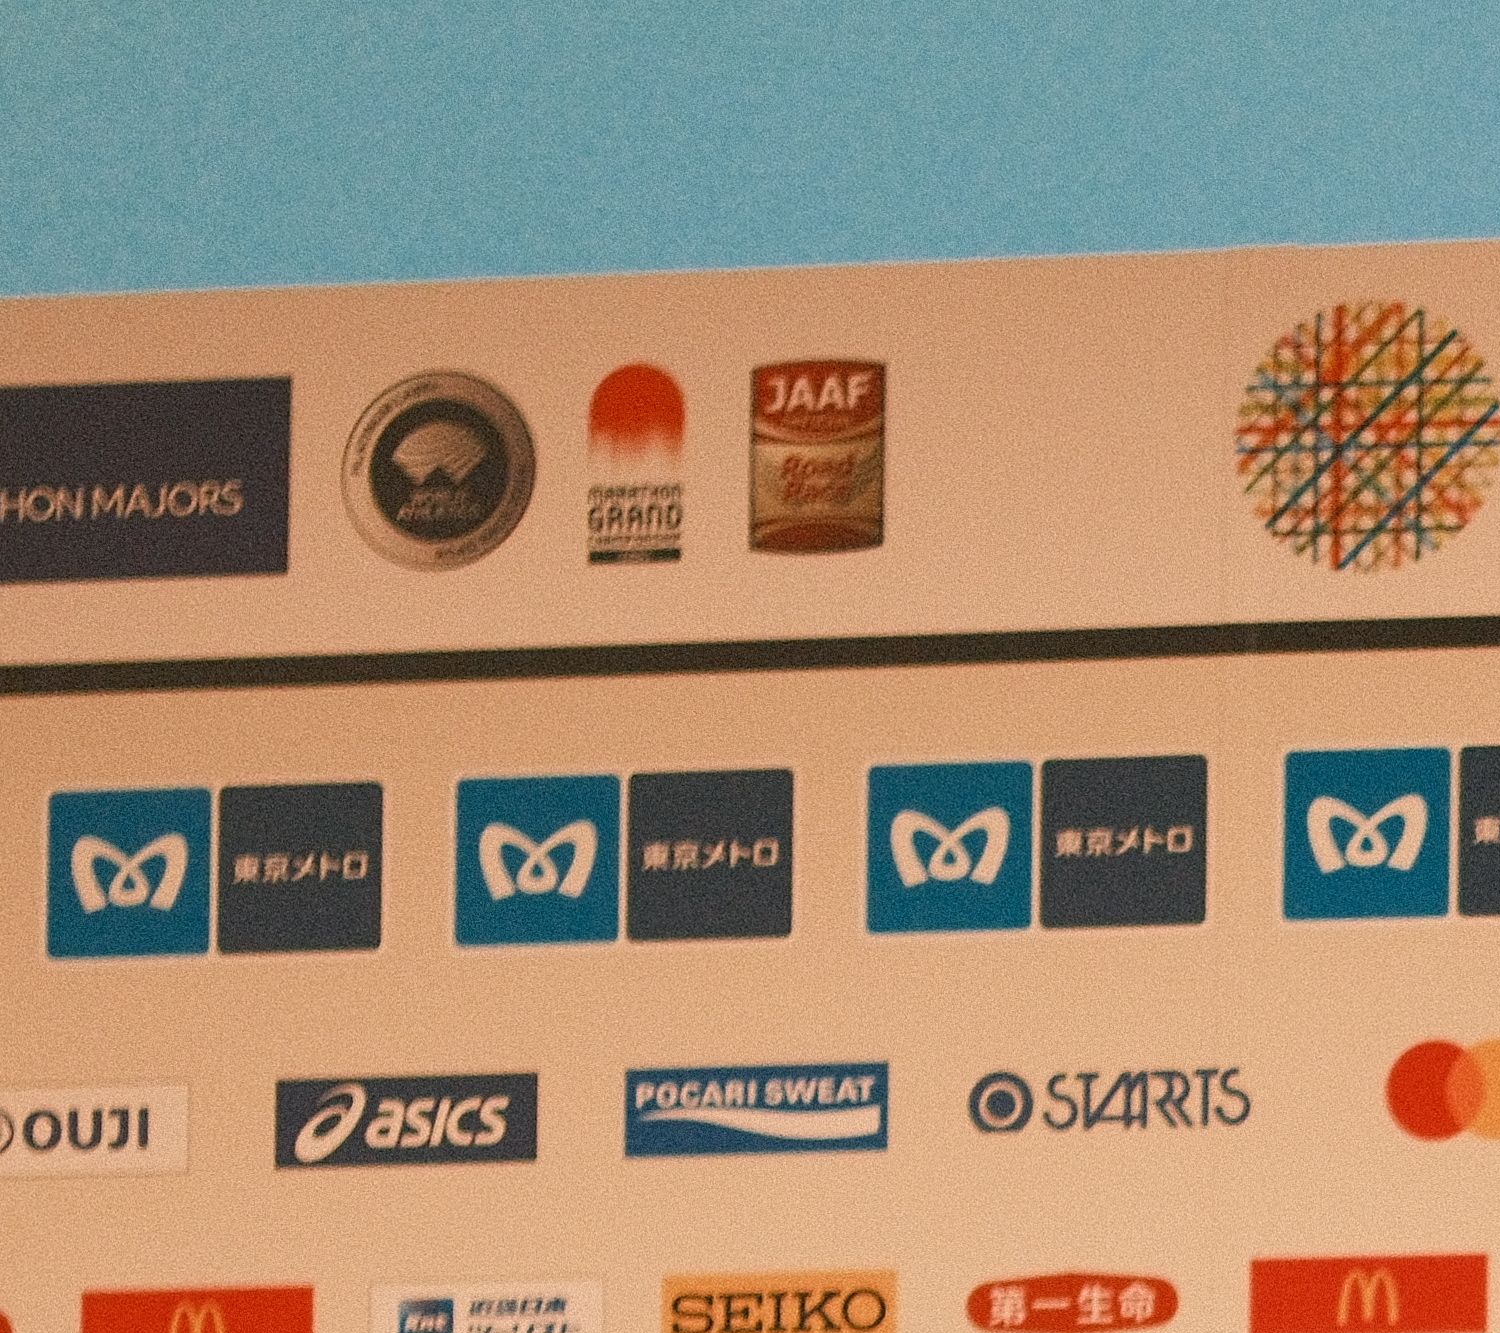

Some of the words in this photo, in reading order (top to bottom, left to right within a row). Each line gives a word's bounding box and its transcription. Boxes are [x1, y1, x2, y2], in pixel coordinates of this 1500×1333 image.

[763, 374, 872, 413] JAAF
[92, 482, 242, 517] MAJORS
[1057, 827, 1192, 855] 東京メトロ
[235, 854, 367, 881] 東京メトロ
[636, 1081, 759, 1106] POCARI
[766, 1077, 874, 1105] SWEAT
[23, 1108, 149, 1151] OUJI
[366, 1097, 508, 1147] asics
[991, 1282, 1155, 1326] 第一生命
